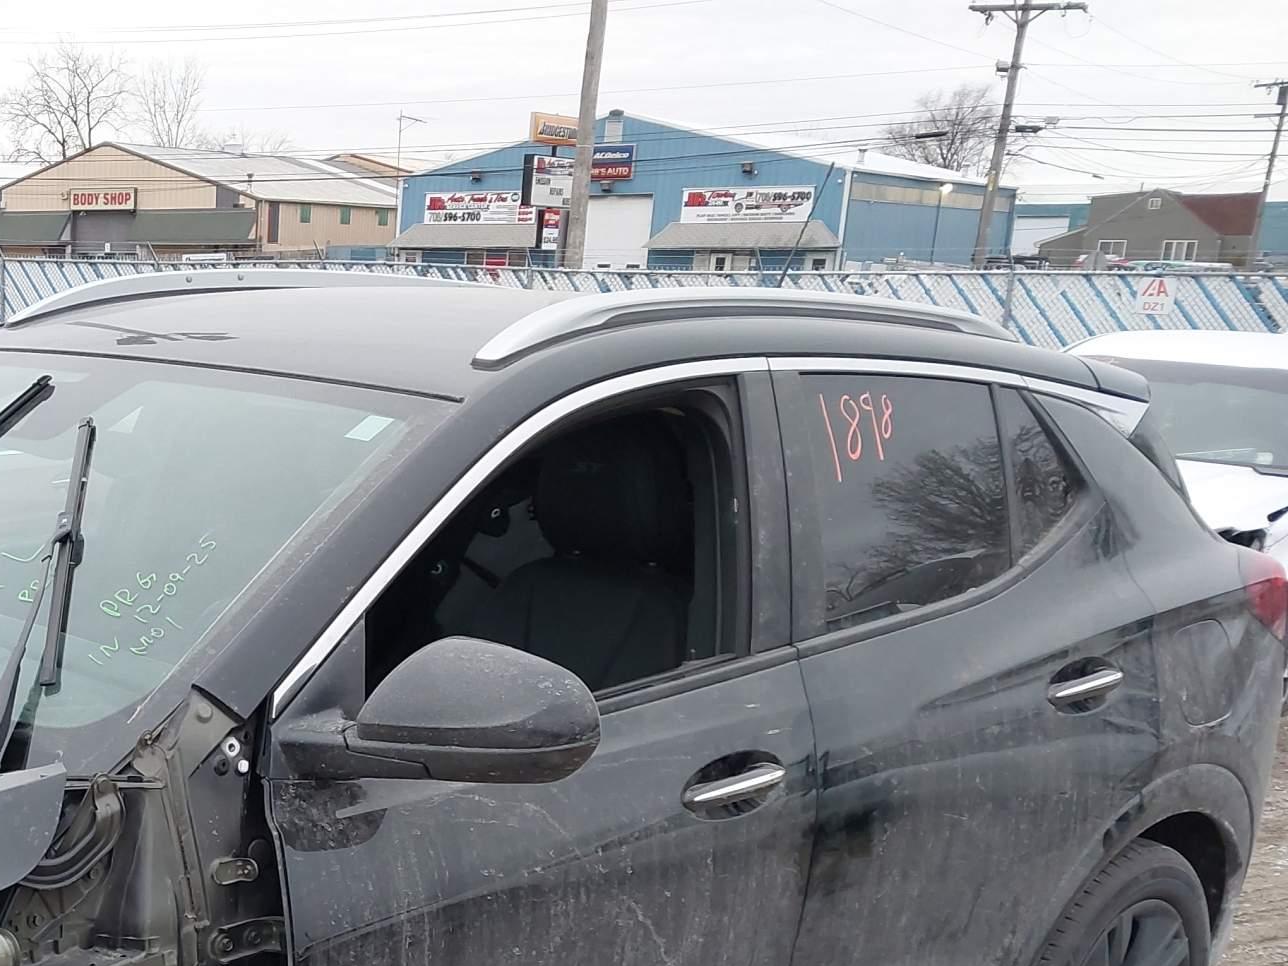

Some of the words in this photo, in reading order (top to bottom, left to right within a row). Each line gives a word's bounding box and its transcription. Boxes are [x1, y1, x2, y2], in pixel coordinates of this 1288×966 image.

[607, 167, 629, 176] AUTO
[72, 193, 100, 206] BODY
[103, 192, 131, 206] SHOP
[819, 391, 893, 483] 1898
